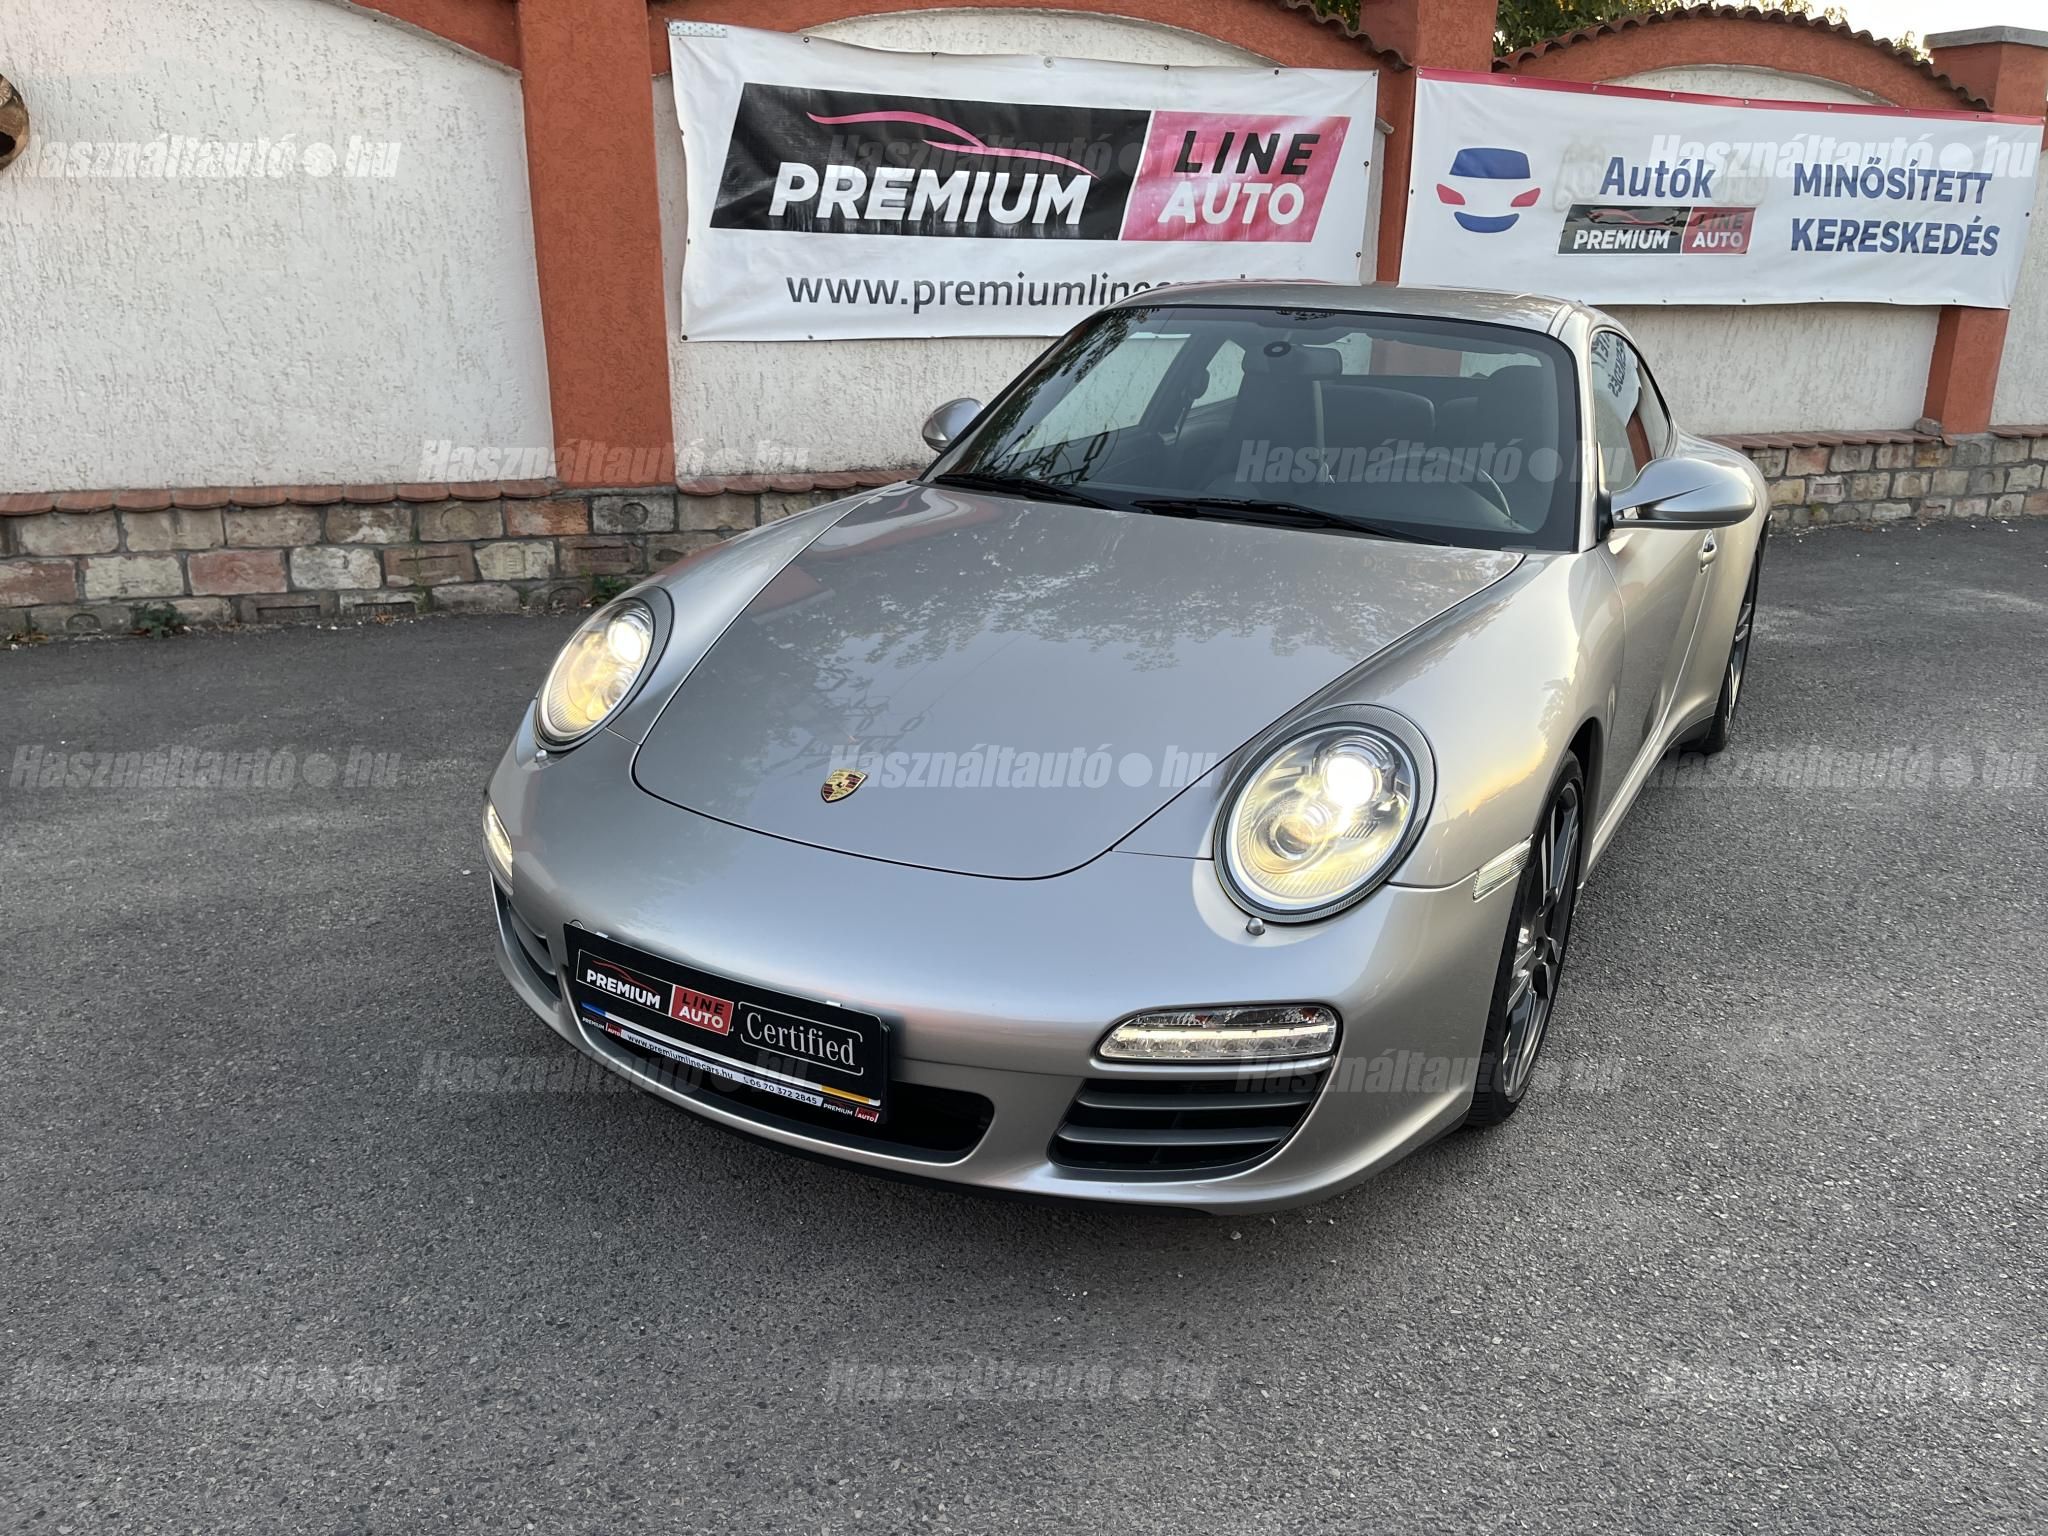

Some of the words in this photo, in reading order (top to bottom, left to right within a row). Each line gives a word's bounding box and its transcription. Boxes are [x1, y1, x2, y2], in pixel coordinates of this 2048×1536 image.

[1176, 129, 1321, 176] LINE
[768, 161, 1093, 226] PREMIUM
[1158, 181, 1306, 227] AUTO
[1600, 157, 1717, 198] Autók
[1792, 155, 1993, 204] MINŐSÍTETT
[1573, 229, 1670, 250] PREMIUM
[1692, 232, 1744, 248] AUTO
[1698, 212, 1744, 230] LINE
[1791, 215, 2000, 257] KERESKEDÉS
[582, 1017, 605, 1030] PREMIUM
[586, 968, 661, 1009] PREMIUM
[679, 1006, 724, 1029] AUTO
[746, 1012, 856, 1066] Certified
[682, 993, 725, 1015] LINE
[627, 1034, 734, 1079] www.premiumlinecars.hu
[750, 1079, 762, 1088] 06
[764, 1082, 775, 1092] 70
[777, 1087, 793, 1098] 372
[795, 1093, 818, 1104] 2845
[823, 1103, 853, 1116] PREMIUM
[857, 1112, 875, 1122] AUTO
